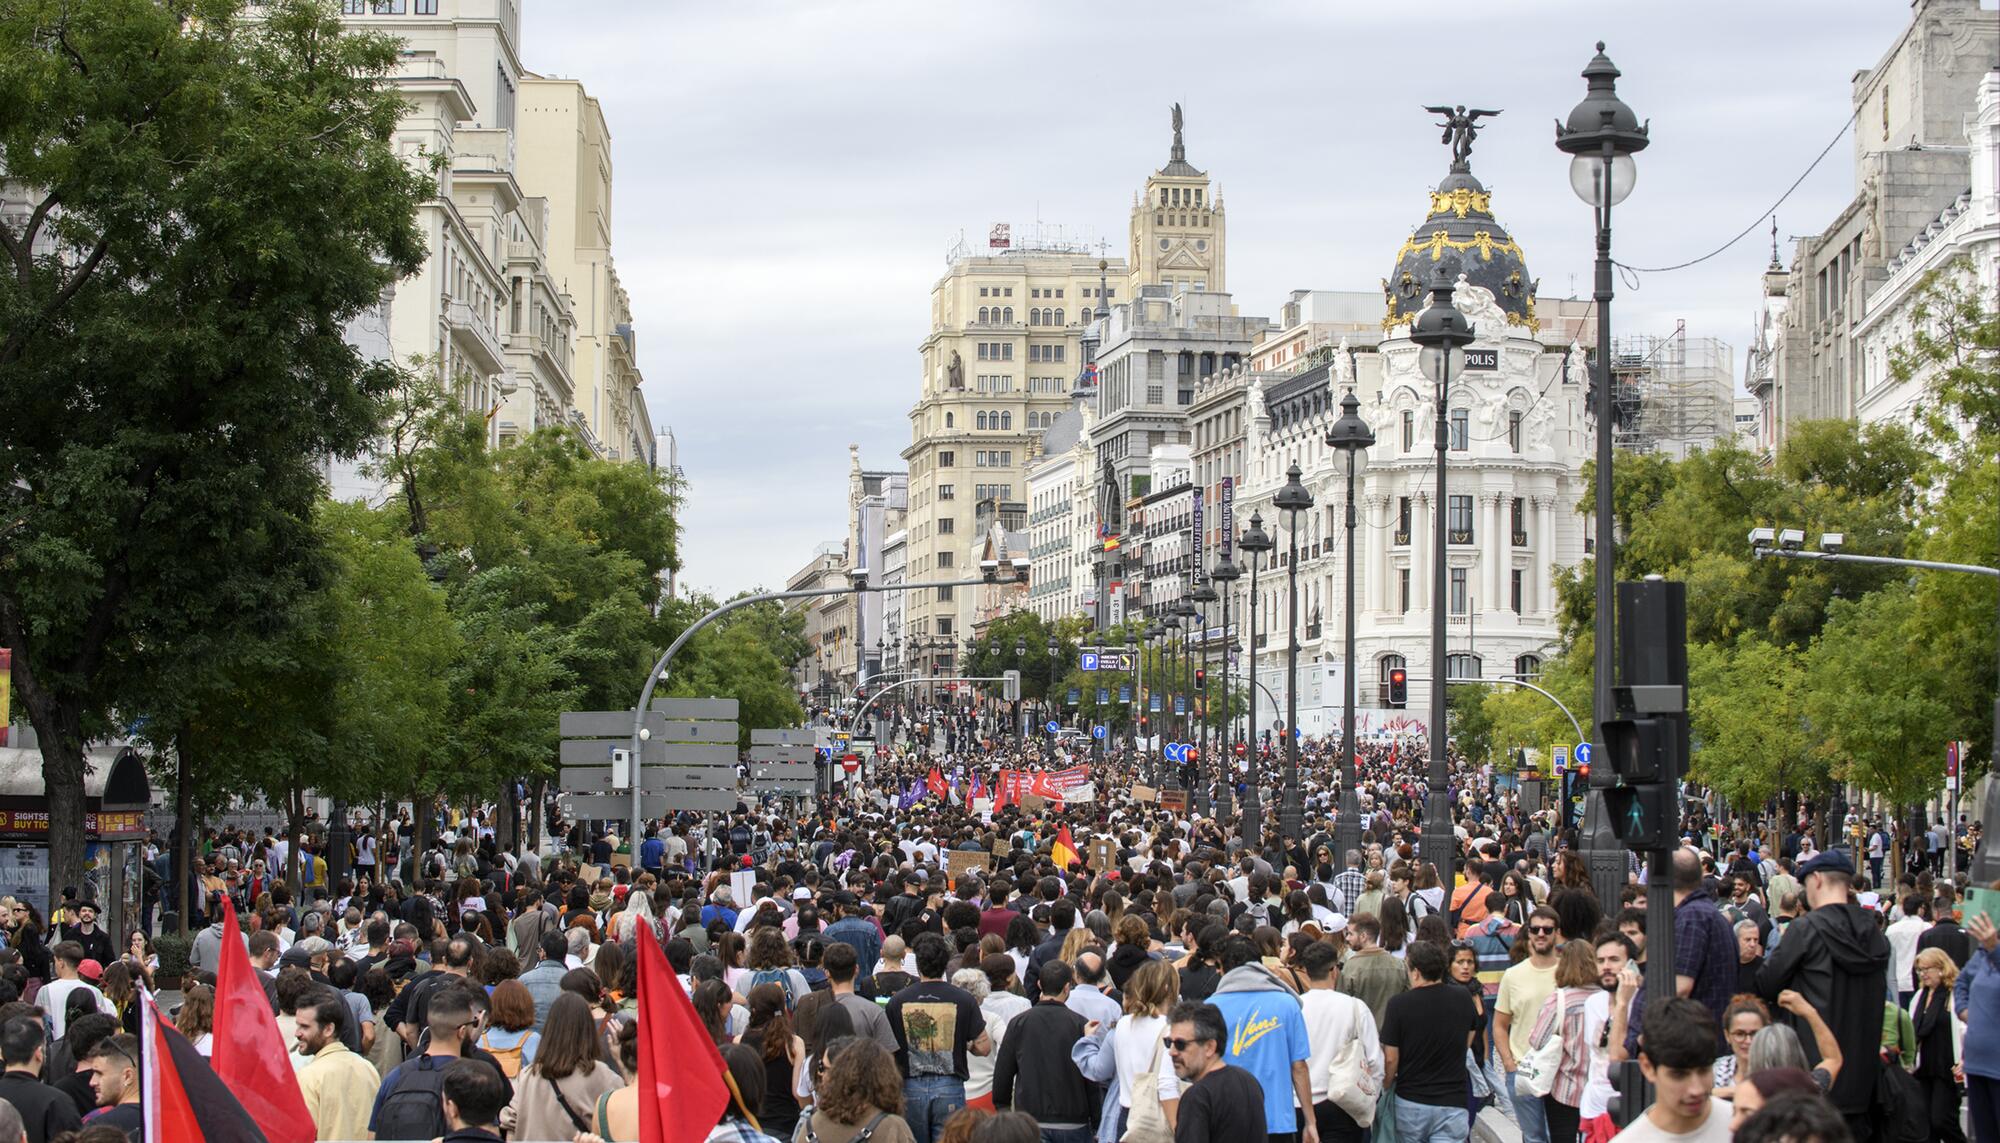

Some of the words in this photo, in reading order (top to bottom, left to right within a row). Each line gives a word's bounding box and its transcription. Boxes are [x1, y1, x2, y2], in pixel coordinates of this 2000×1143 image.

[1464, 354, 1495, 366] POLIS
[1194, 512, 1202, 552] MUJERES
[1086, 656, 1095, 668] P
[14, 812, 49, 820] SIGHTSE
[86, 813, 97, 821] RS
[14, 821, 32, 829] BUY
[33, 821, 49, 829] TIC
[85, 821, 97, 830] RE
